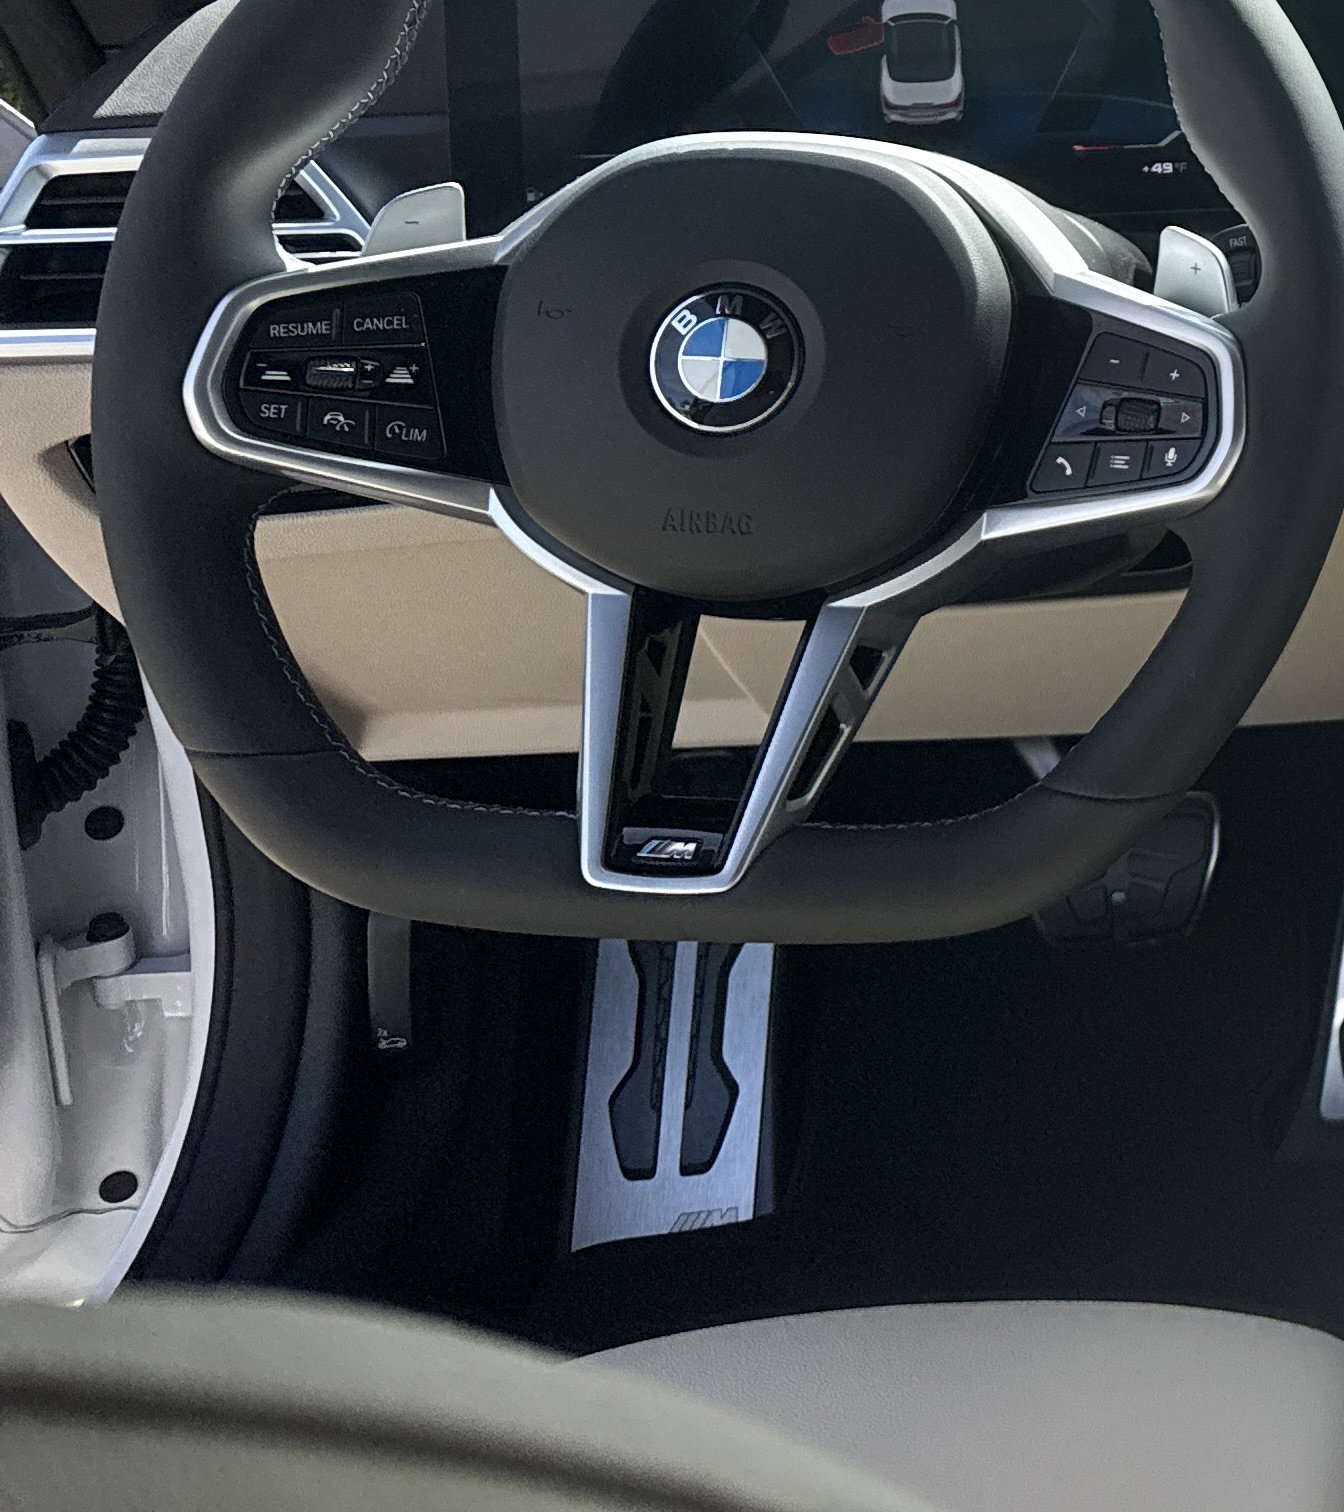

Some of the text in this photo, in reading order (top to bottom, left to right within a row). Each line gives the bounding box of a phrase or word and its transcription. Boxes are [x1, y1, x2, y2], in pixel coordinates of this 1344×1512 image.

[269, 315, 409, 338] RESUME CANCEL
[670, 294, 787, 339] BMW
[259, 404, 289, 419] SET
[402, 427, 428, 442] LIM
[661, 507, 753, 535] AIRBAG
